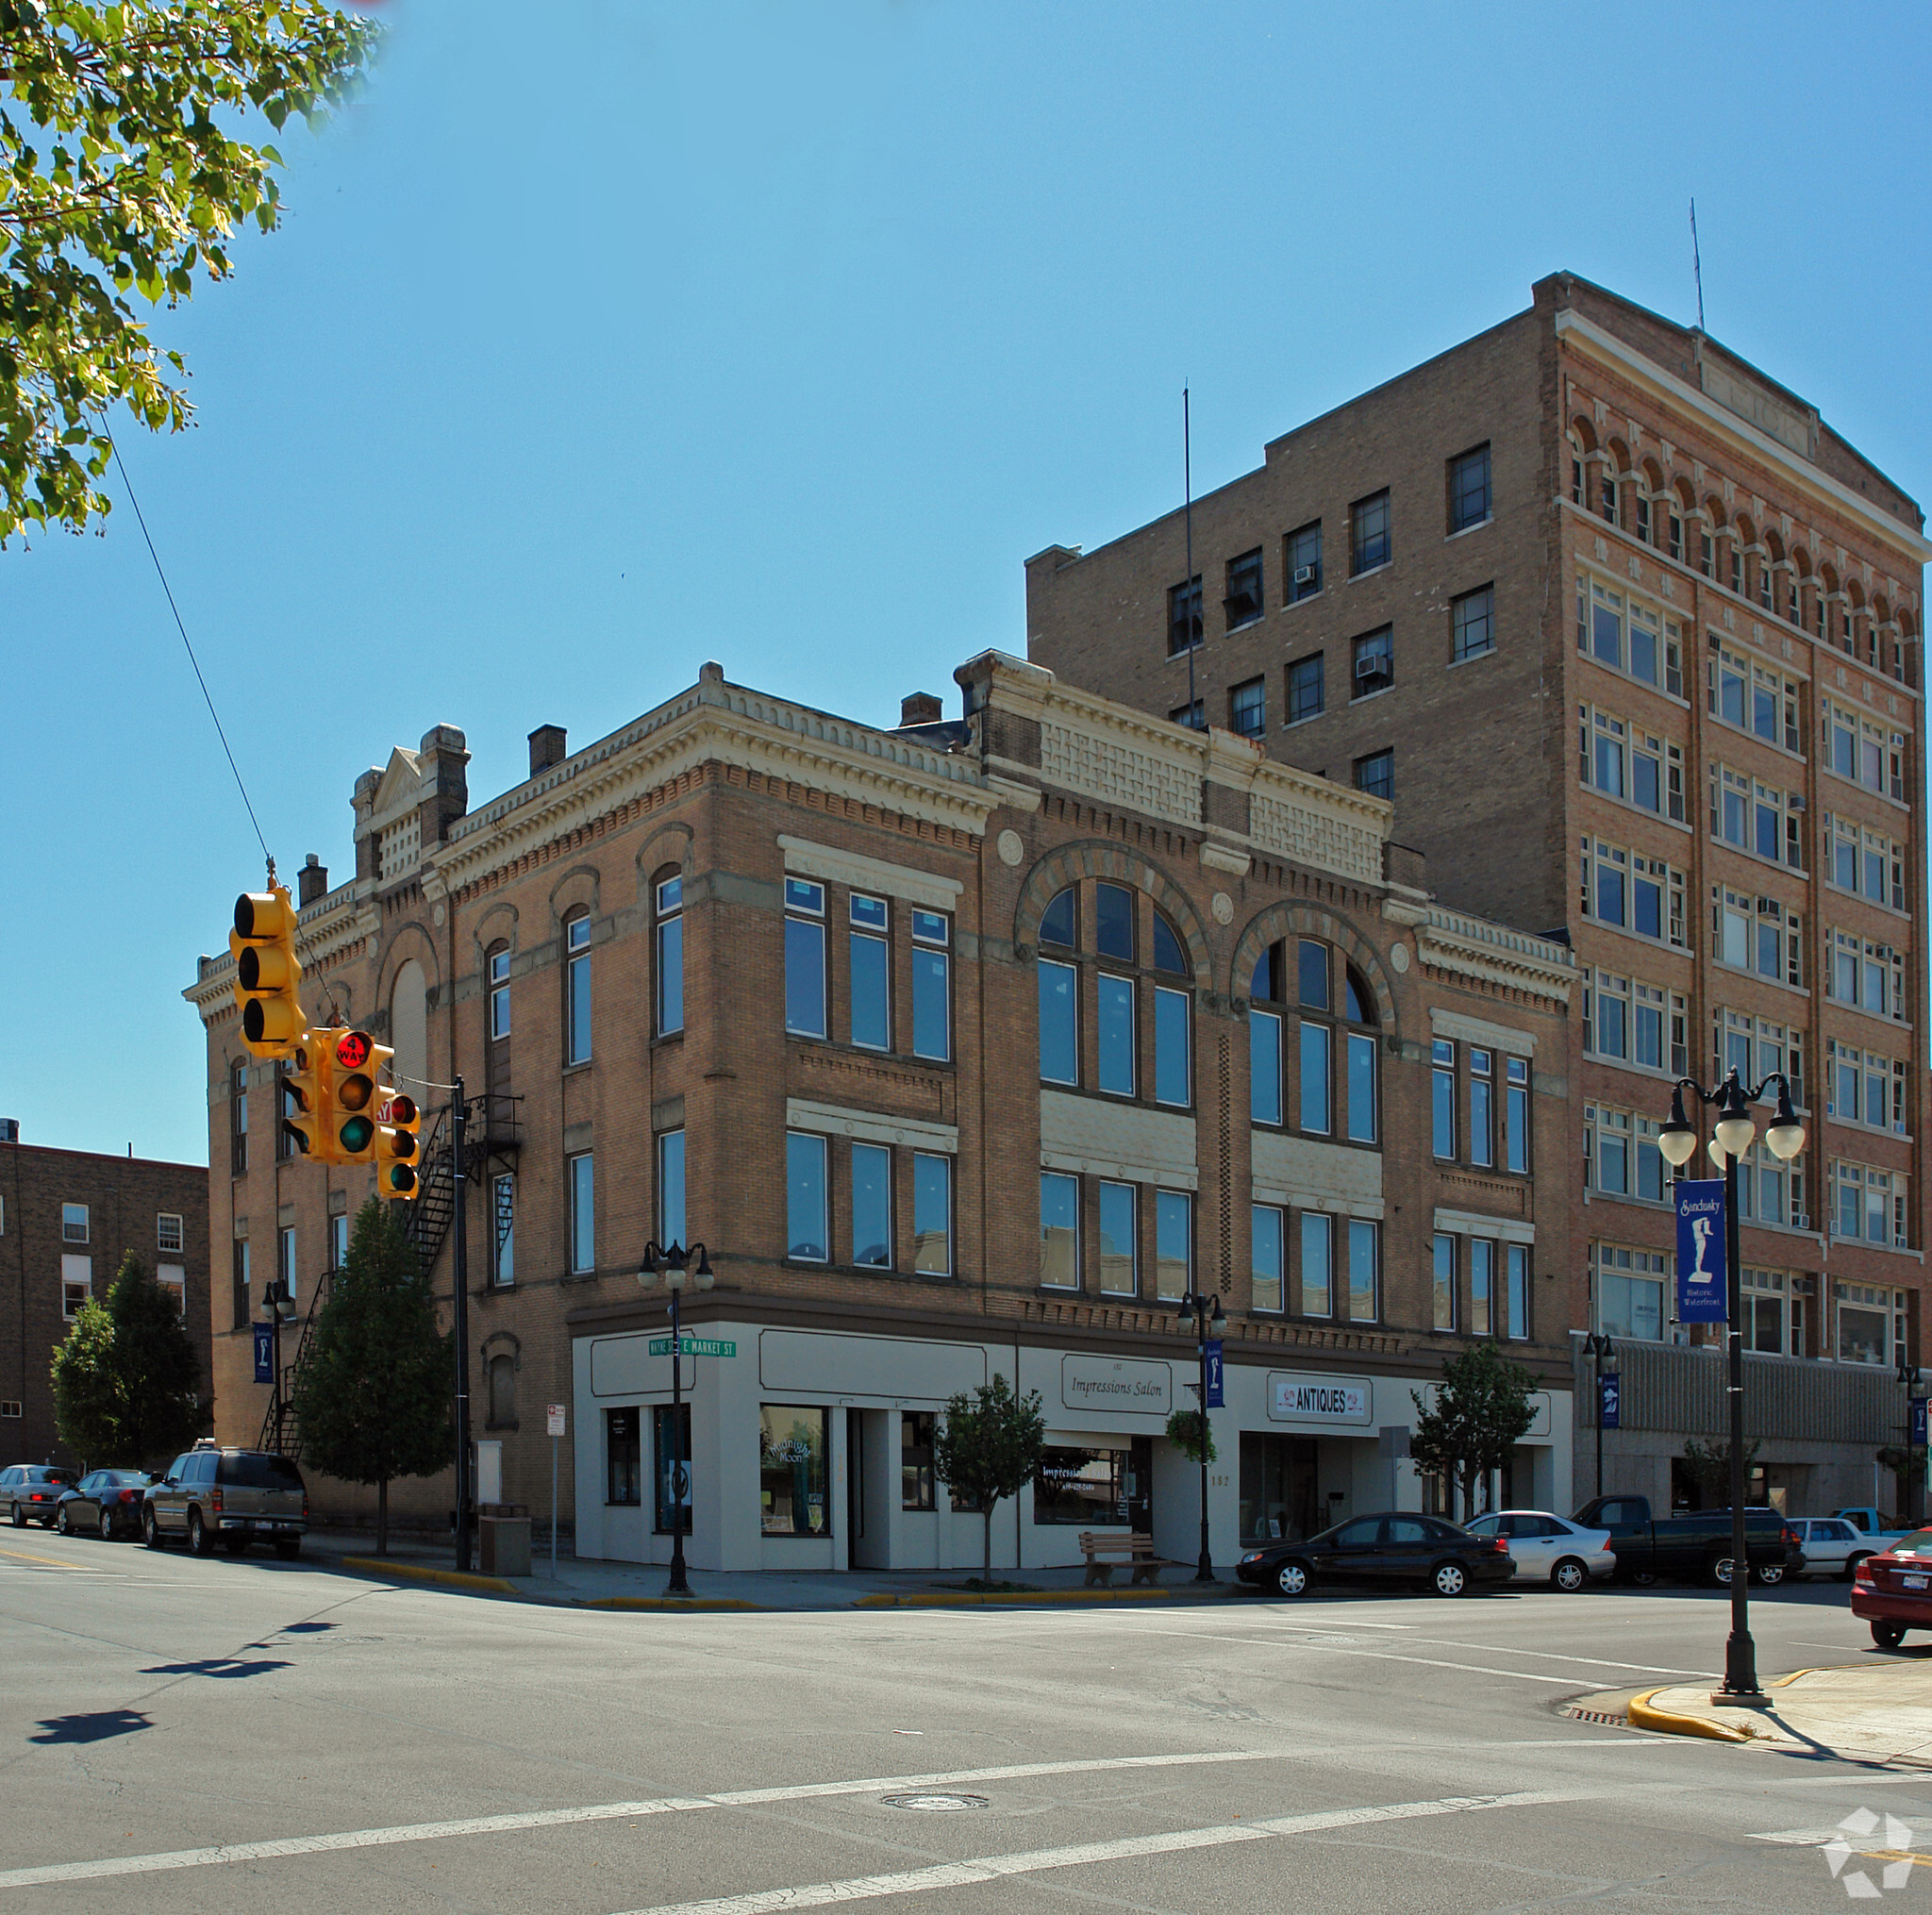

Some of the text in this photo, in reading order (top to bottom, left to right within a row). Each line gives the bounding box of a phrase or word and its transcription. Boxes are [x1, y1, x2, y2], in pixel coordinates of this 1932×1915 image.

[1706, 367, 1802, 448] FEICK
[347, 1039, 357, 1050] 4
[340, 1050, 366, 1064] WAY
[1680, 1198, 1721, 1217] Sandusky
[667, 1339, 674, 1352] S
[683, 1340, 732, 1356] E MARKET ST
[1072, 1377, 1162, 1397] Impressions Salon
[1296, 1387, 1346, 1413] ANTIQUES
[769, 1438, 811, 1458] Midnight
[779, 1452, 803, 1463] Moon
